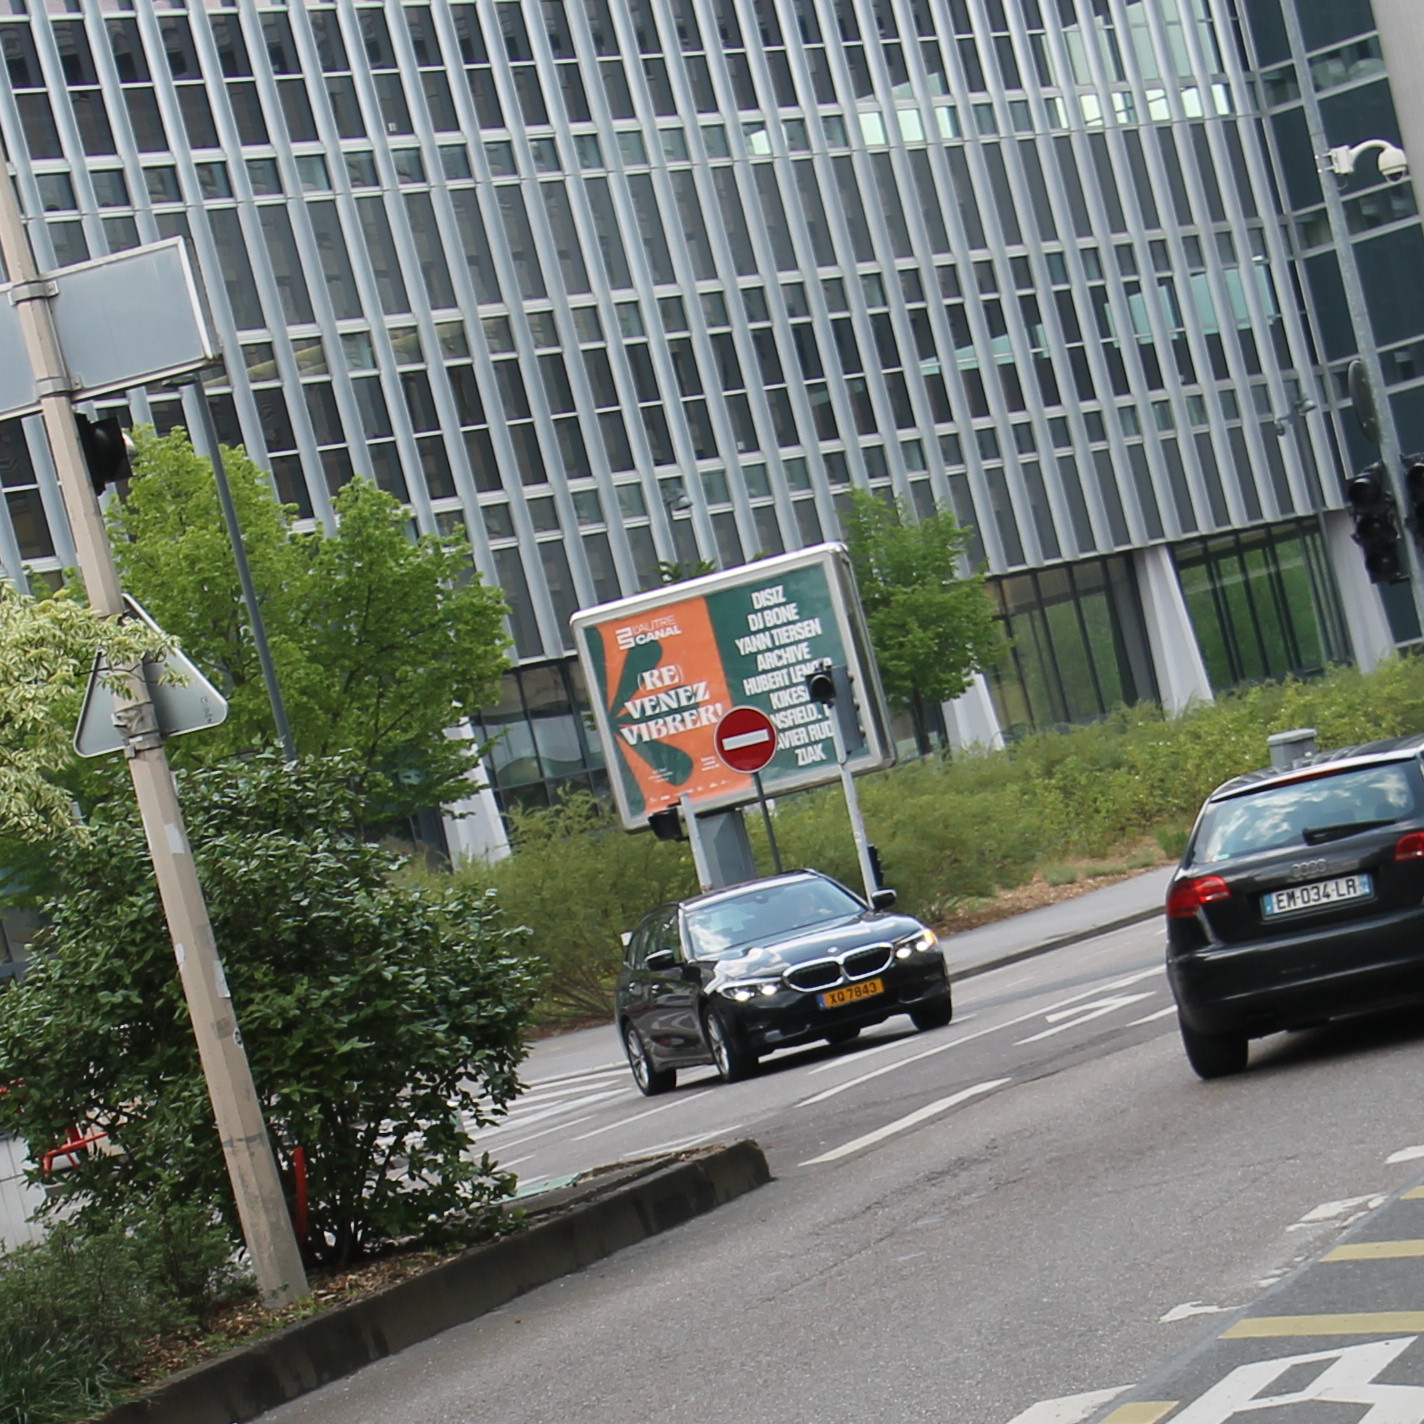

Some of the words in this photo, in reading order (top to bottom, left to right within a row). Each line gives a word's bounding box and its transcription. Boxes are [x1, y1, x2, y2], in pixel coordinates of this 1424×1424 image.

[751, 585, 787, 610] DISIZ
[747, 612, 764, 631] DJ
[763, 603, 799, 627] BONE
[636, 625, 682, 645] CANAL
[735, 631, 773, 656] YANN
[770, 618, 823, 646] TIERSEN
[756, 641, 812, 672] ARCHIVE
[637, 663, 683, 693] (RE)
[742, 668, 790, 696] HUBERT
[624, 681, 710, 719] VENEZ
[794, 743, 828, 767] ZIAK
